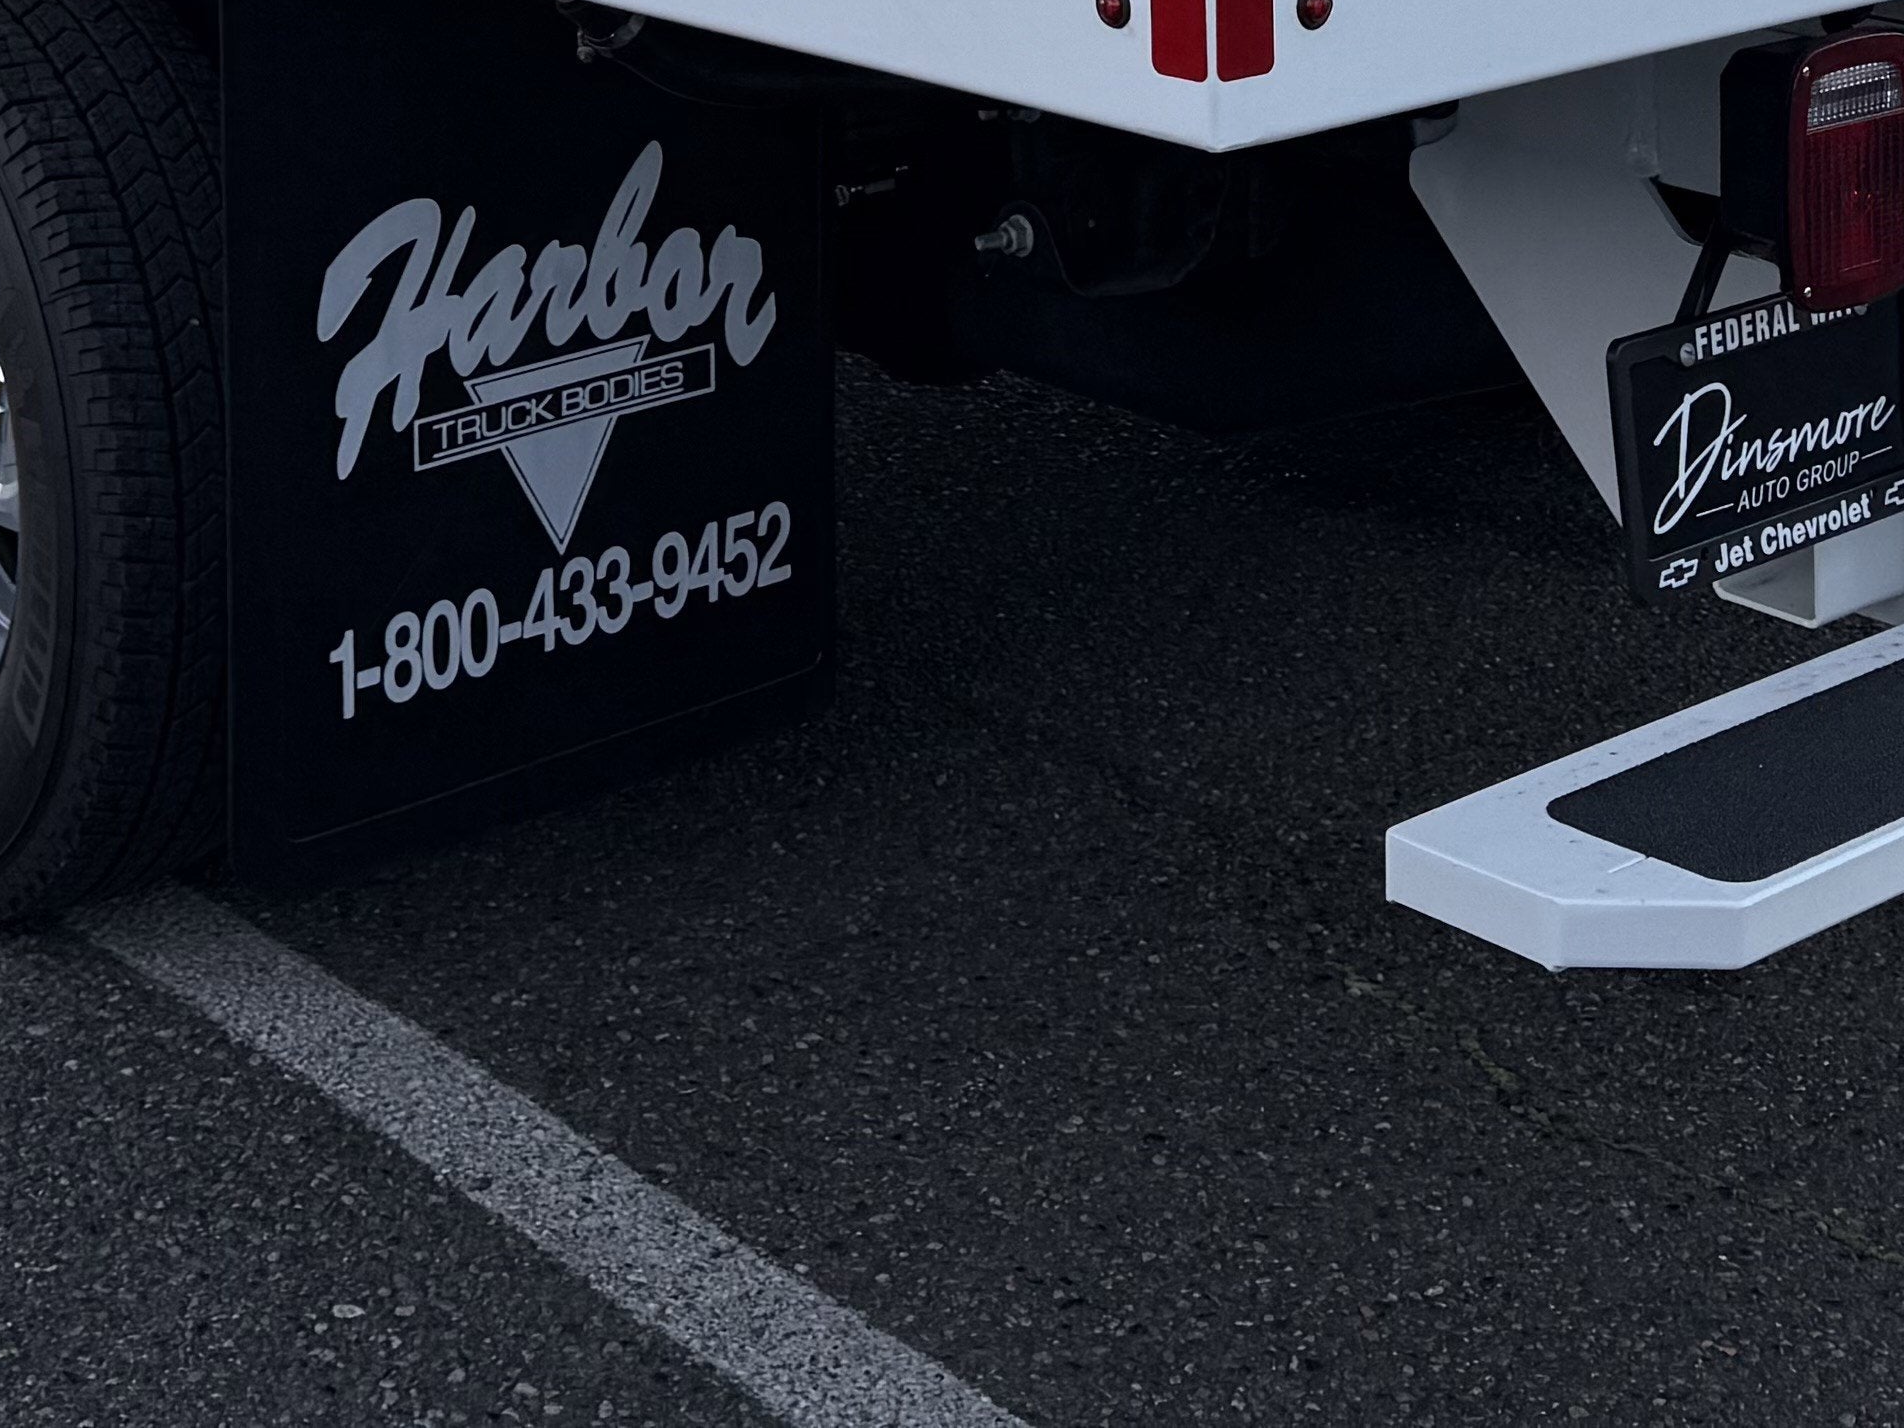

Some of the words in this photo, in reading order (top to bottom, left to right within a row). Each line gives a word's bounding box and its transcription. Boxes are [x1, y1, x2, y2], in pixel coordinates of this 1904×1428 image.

[316, 139, 778, 481] Harbor
[1696, 301, 1801, 361] FEDERAL
[432, 396, 556, 452] TRUCK
[561, 360, 685, 415] BODIES
[1652, 381, 1896, 535] Dinsmore
[1737, 474, 1789, 514] AUTO
[1796, 451, 1861, 493] GROUP
[1714, 534, 1756, 574] Jet
[1760, 494, 1873, 556] Chevrolet
[328, 500, 793, 720] 1-800-433-9452
